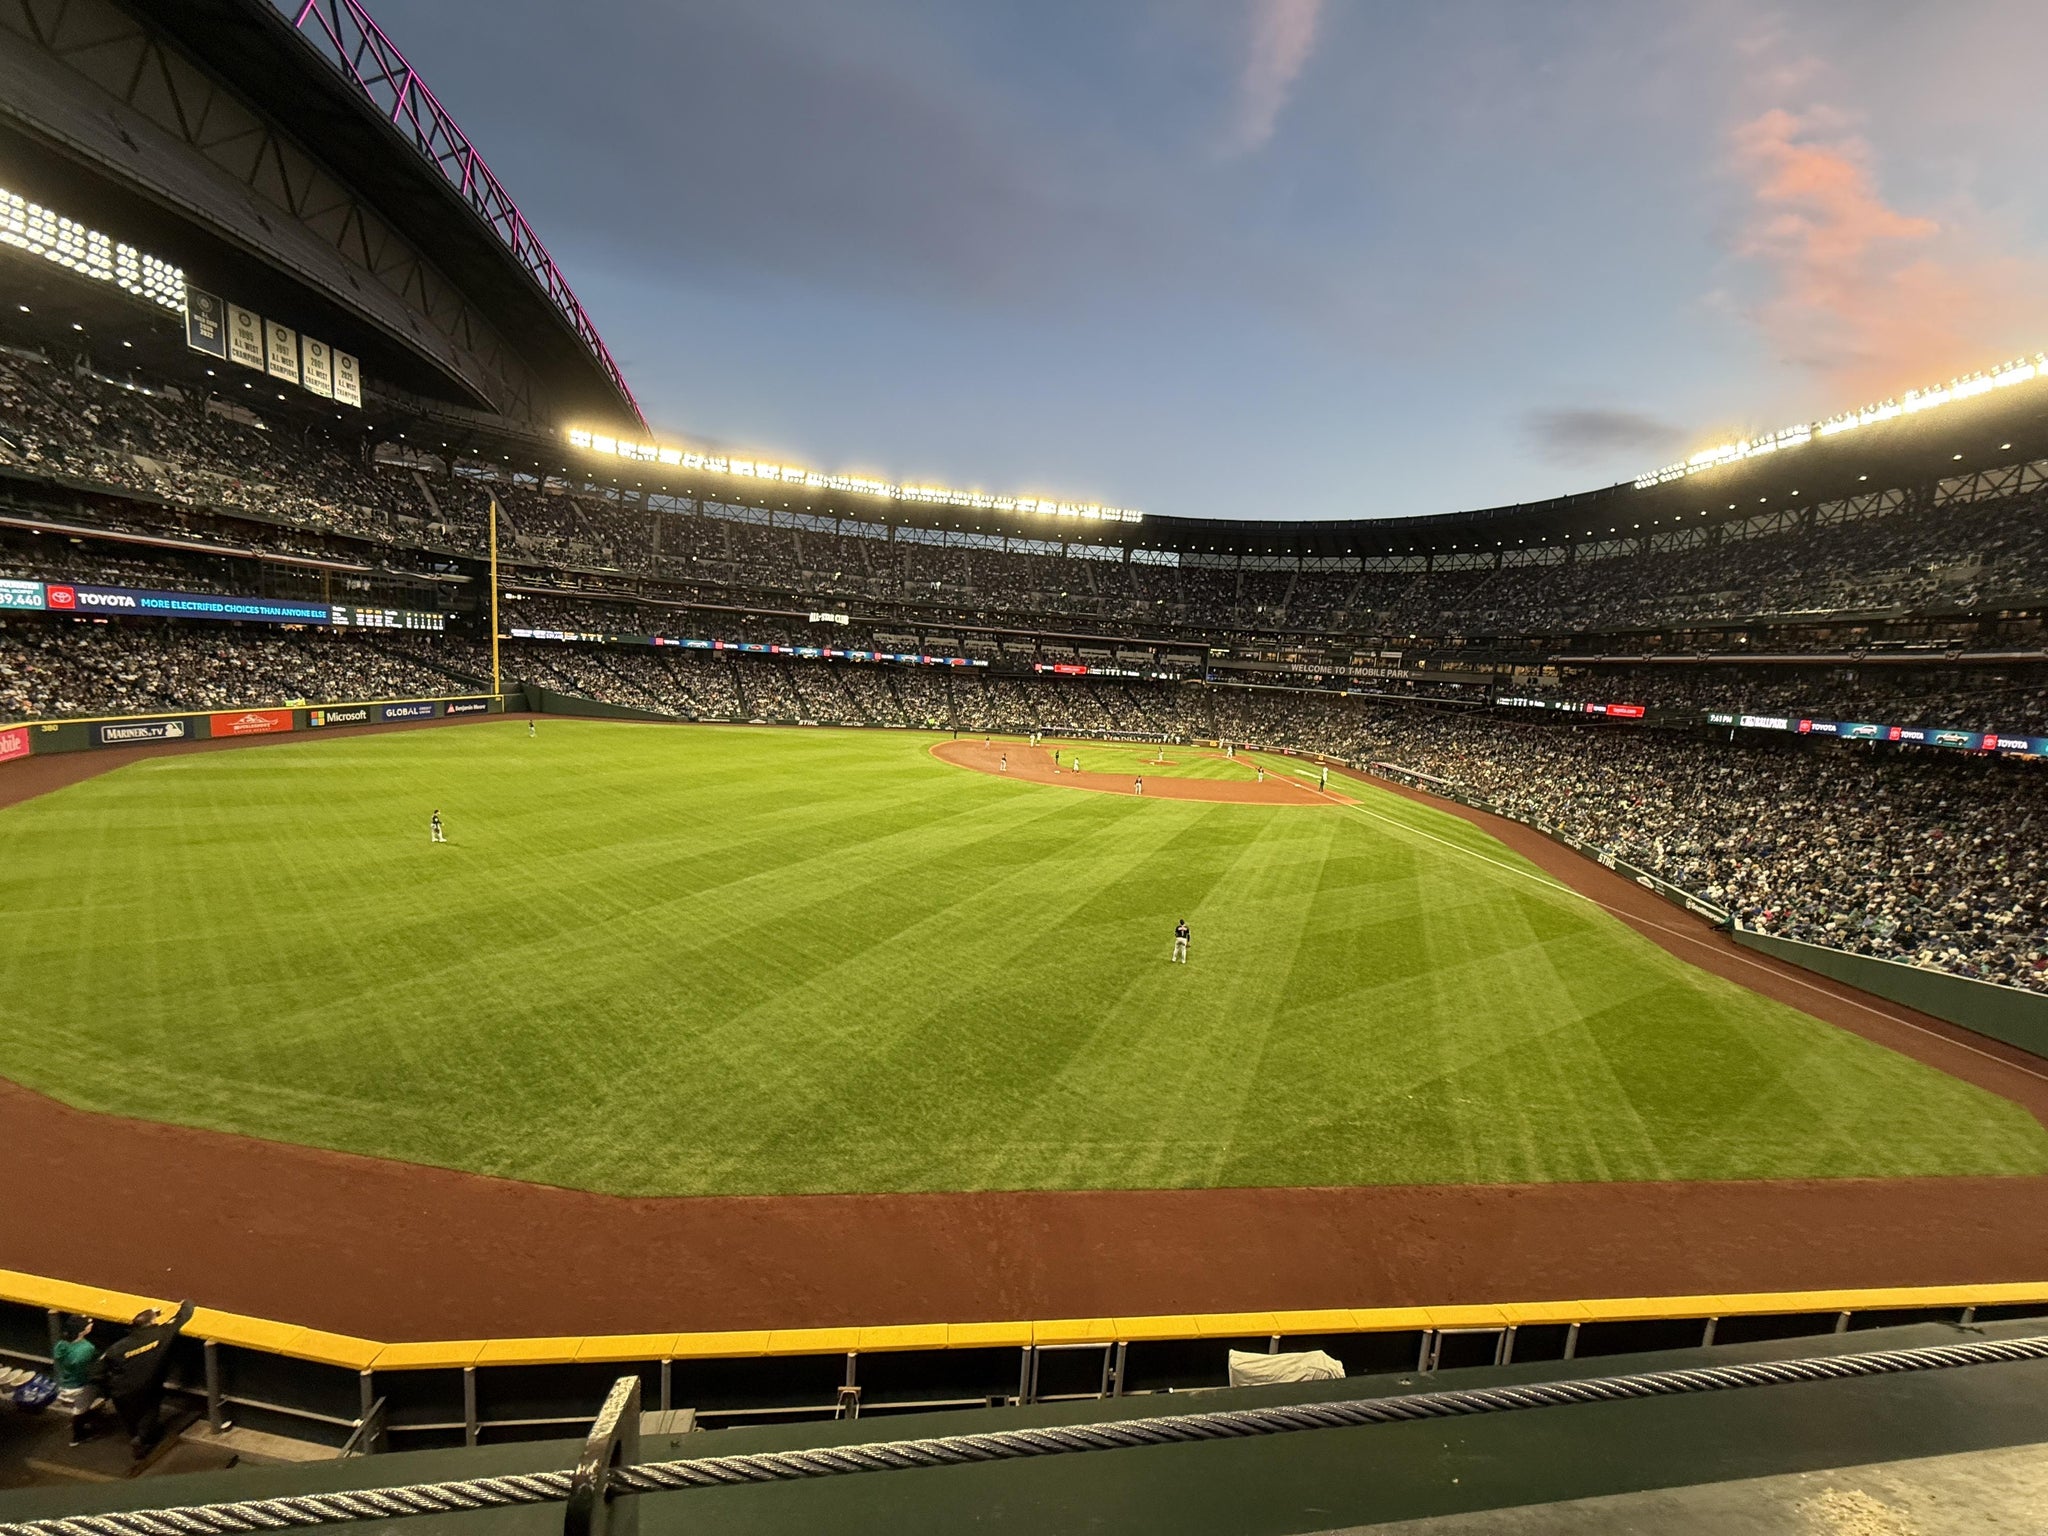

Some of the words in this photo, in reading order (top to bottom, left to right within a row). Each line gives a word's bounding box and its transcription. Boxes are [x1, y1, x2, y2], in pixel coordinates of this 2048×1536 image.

[244, 342, 259, 354] WEST
[232, 348, 263, 366] CHAMPIONS
[280, 356, 294, 368] WEST
[269, 362, 298, 379] CHAMPIONS
[315, 370, 328, 381] WEST
[305, 376, 330, 391] CHAMPIONS
[78, 593, 136, 608] TOYOTA
[141, 599, 170, 609] MORE
[171, 600, 224, 612] ELECTRIFIED
[224, 604, 259, 614] CHOICES
[260, 606, 280, 615] THAN
[281, 608, 310, 617] ANYONE
[311, 610, 326, 618] ELSE
[1291, 663, 1333, 674] WELCOME
[1334, 666, 1346, 675] TO
[1348, 667, 1385, 677] T-MOBILE
[1386, 669, 1409, 678] PARK
[326, 710, 367, 722] Microsoft
[386, 707, 418, 717] GLOBAL
[1812, 723, 1837, 732] TOYOTA
[1901, 731, 1924, 740] TOYOTA
[1997, 739, 2028, 750] TOYOTA
[1597, 853, 1616, 870] STIHL
